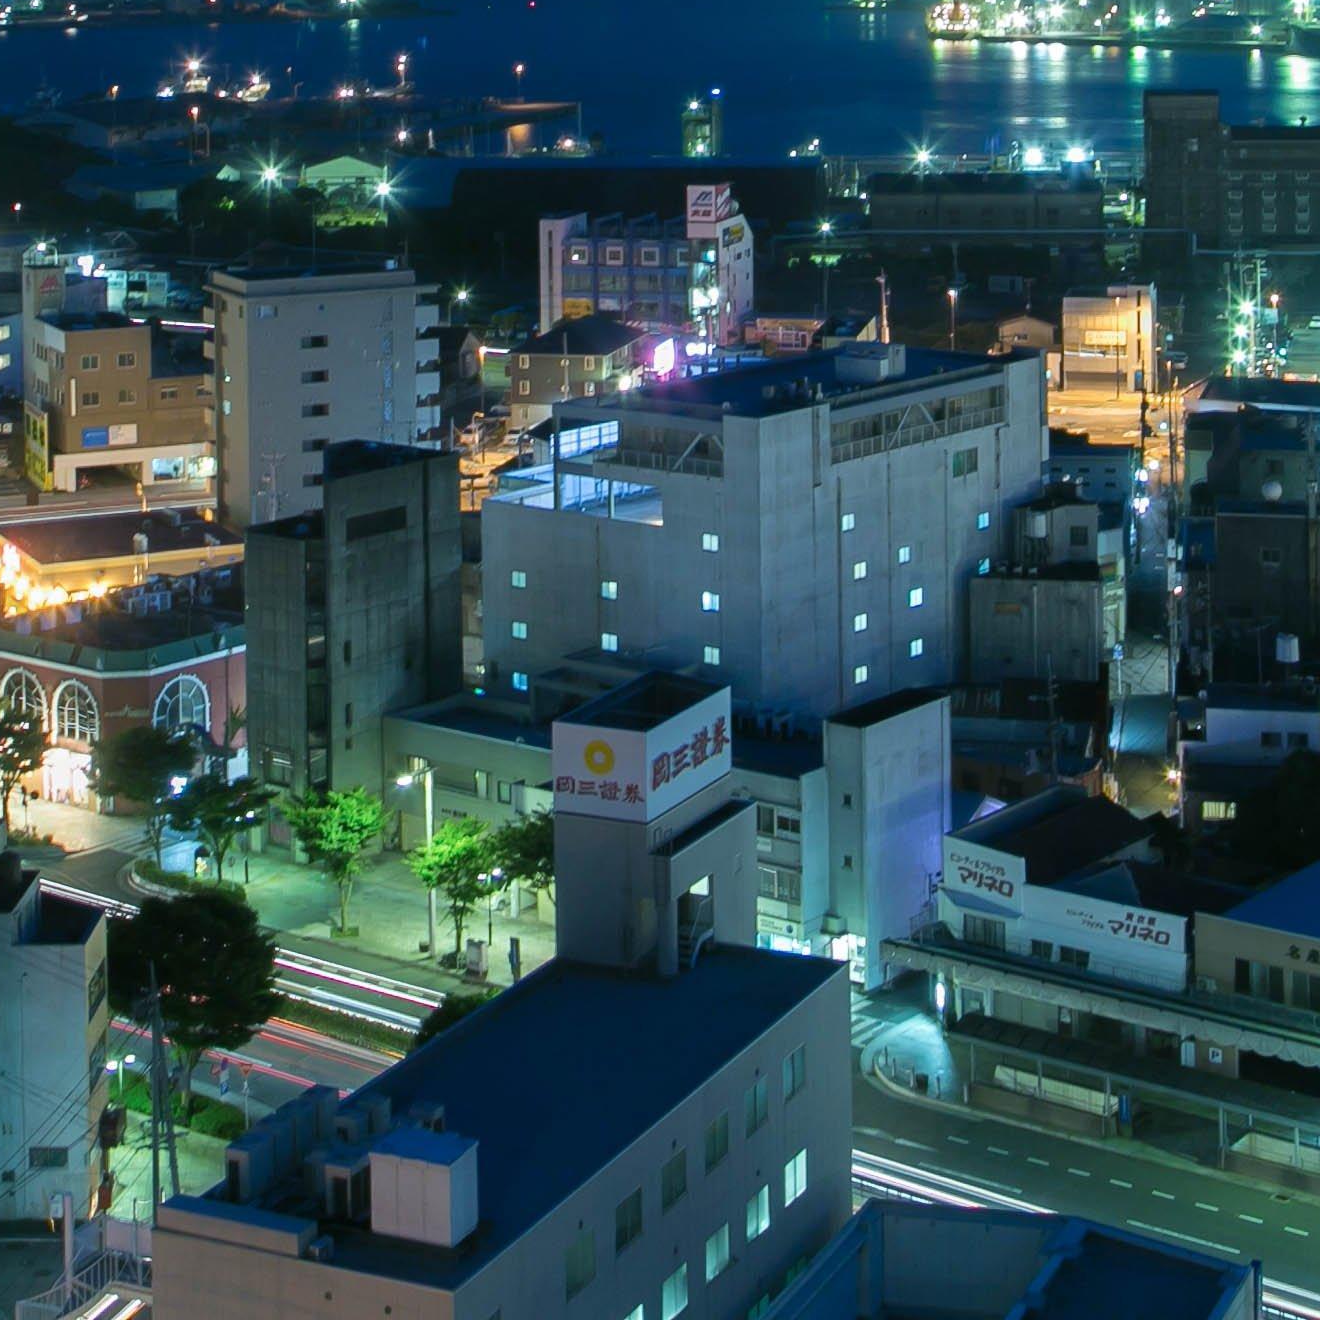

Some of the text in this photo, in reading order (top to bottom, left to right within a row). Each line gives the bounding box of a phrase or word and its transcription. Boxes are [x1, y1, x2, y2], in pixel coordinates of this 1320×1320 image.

[651, 714, 730, 791] 岡三證券
[555, 775, 645, 804] 岡三證券
[957, 866, 1015, 899] マリネロ
[1108, 919, 1171, 946] マリネロ
[1211, 1050, 1220, 1060] P
